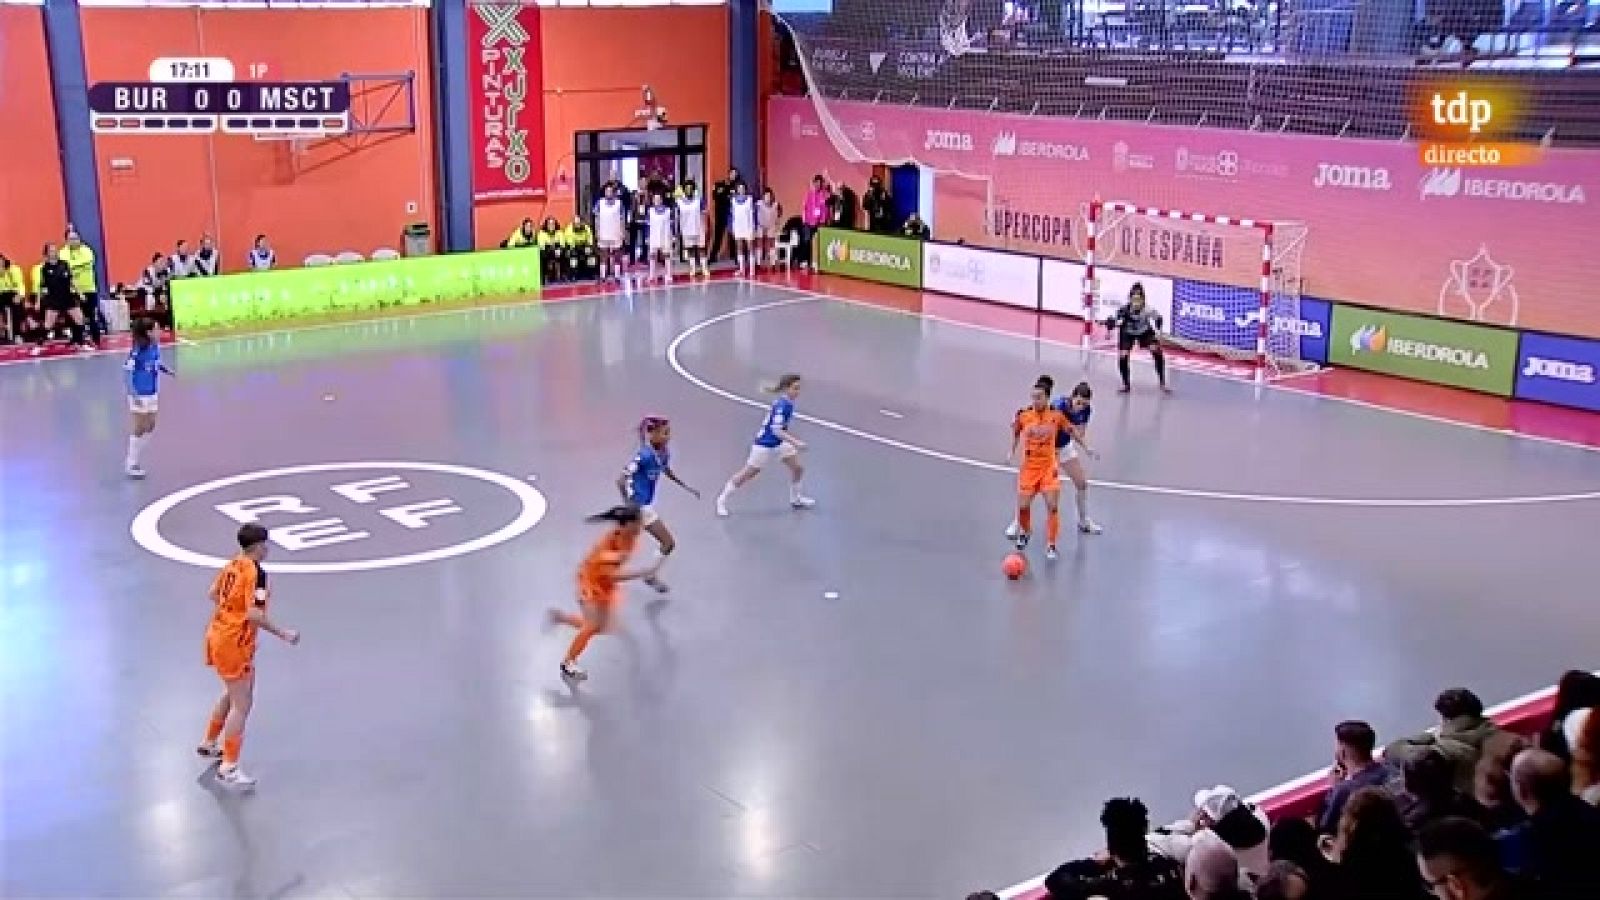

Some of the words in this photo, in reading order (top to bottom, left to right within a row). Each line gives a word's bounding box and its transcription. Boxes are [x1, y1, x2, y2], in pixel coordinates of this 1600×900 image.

[482, 50, 505, 168] PINTURAS
[1017, 141, 1090, 161] IBERDROLA
[1464, 179, 1586, 203] IBERDROLA
[1121, 227, 1143, 256] DE
[850, 248, 911, 271] IBERDROLA
[1386, 337, 1489, 369] IBERDROLA
